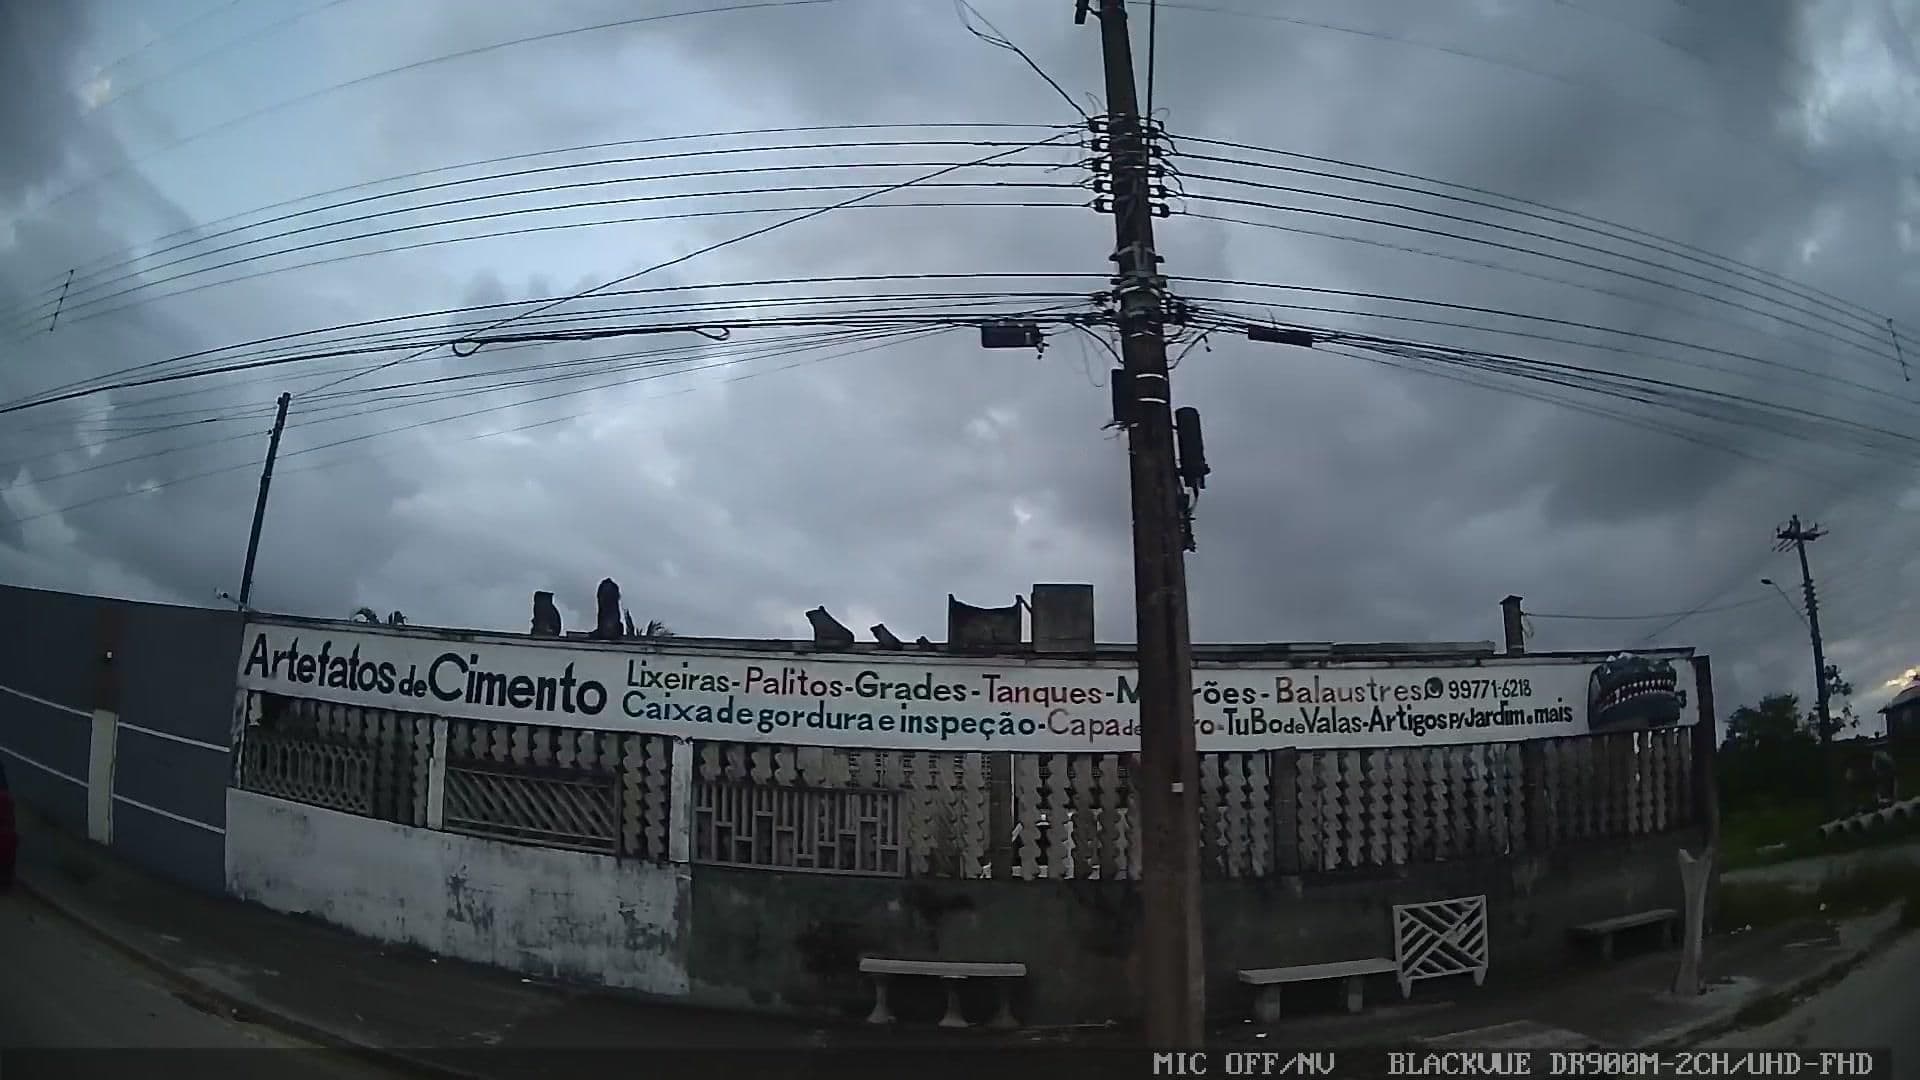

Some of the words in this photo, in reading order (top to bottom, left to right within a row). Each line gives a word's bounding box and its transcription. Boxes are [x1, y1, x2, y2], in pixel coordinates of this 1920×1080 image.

[244, 632, 397, 694] Artefatos
[399, 664, 427, 698] de
[428, 652, 607, 715] Cimento
[1275, 675, 1422, 704] Balaustres
[1448, 678, 1532, 699] 99771-6218
[622, 690, 712, 723] Caixa
[716, 695, 753, 725] de
[756, 700, 874, 734] gordura
[878, 718, 895, 732] e
[1047, 708, 1119, 743] Capa
[1368, 704, 1447, 737] Artigos
[1464, 700, 1526, 728] Jardim
[1534, 697, 1573, 724] mais
